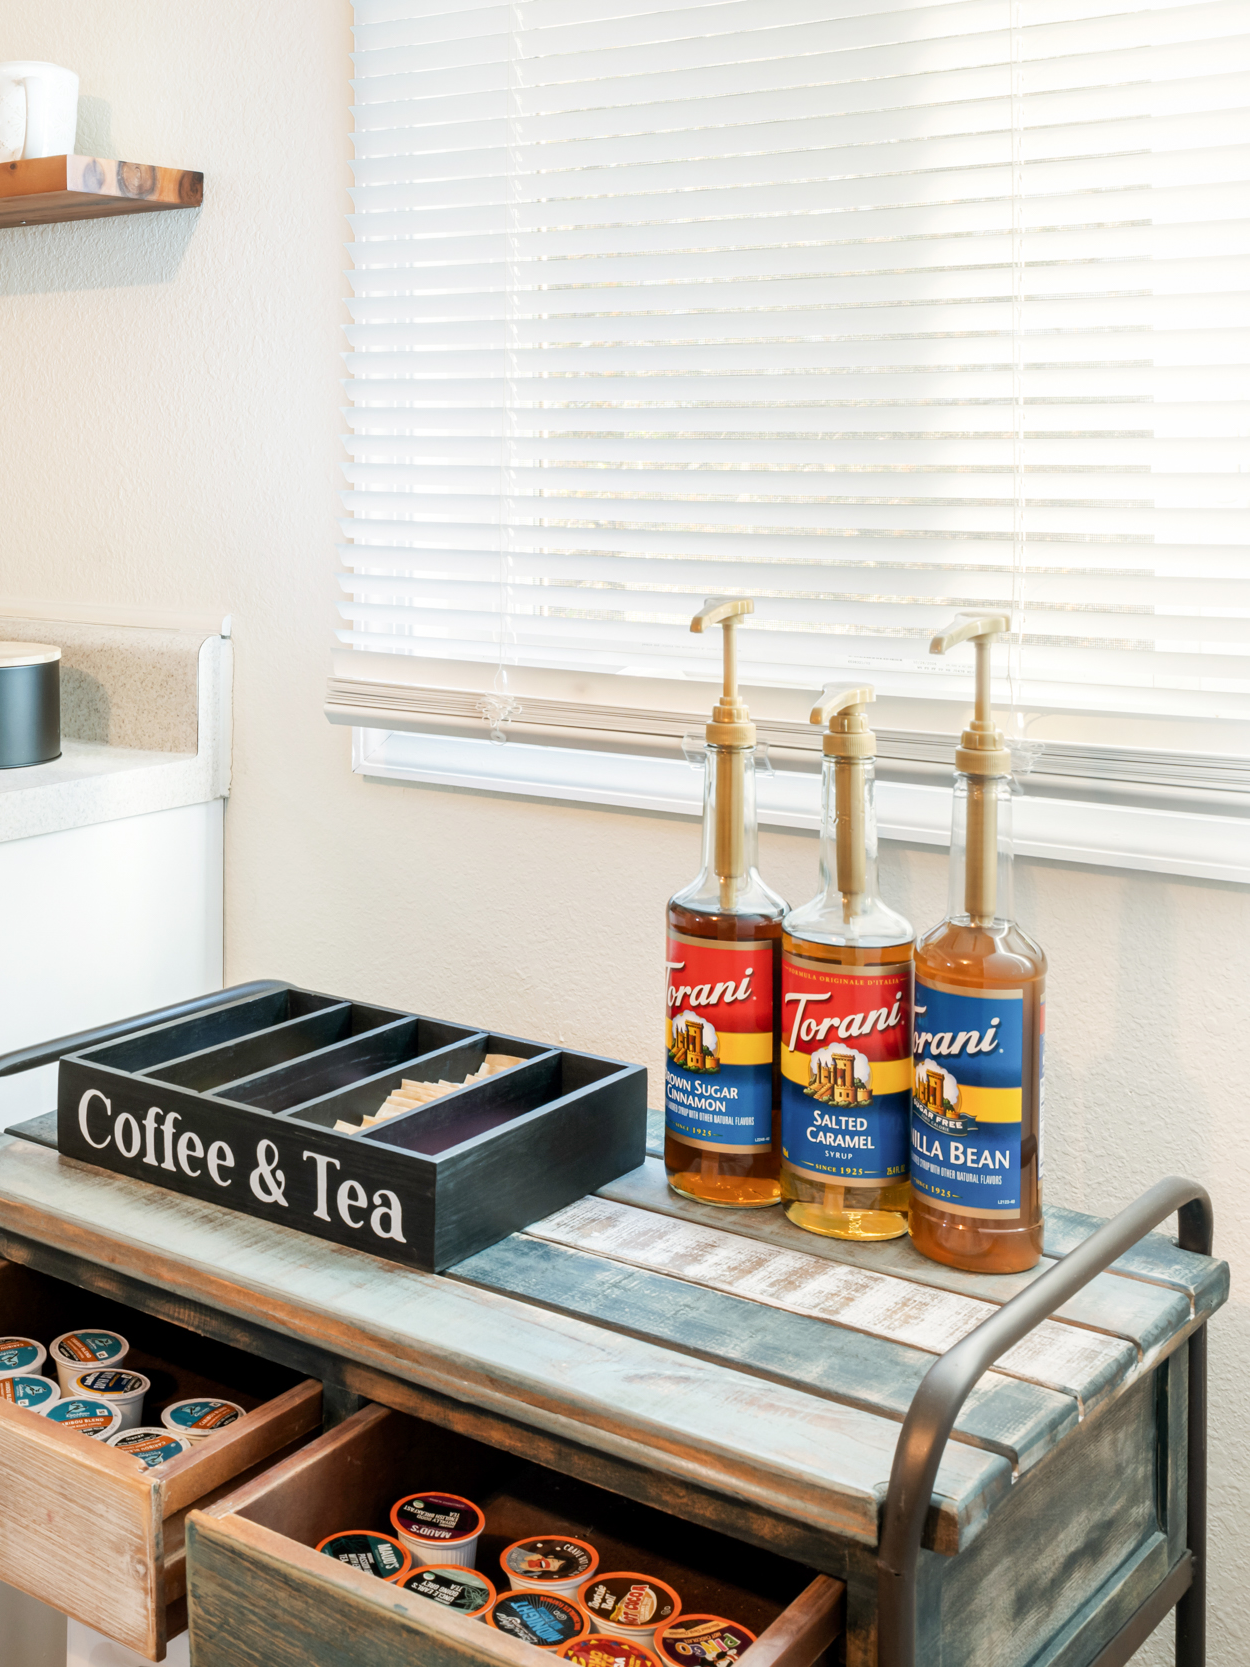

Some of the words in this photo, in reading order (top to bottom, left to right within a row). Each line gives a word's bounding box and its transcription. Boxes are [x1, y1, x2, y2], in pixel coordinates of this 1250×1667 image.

[819, 976, 864, 986] ORIGINALE
[868, 978, 900, 986] D'ITALIA
[785, 991, 902, 1052] Torani
[666, 1066, 691, 1092] ROWN
[694, 1080, 738, 1099] SUGAR
[667, 1084, 726, 1112] CINNAMON
[735, 1117, 754, 1126] FLAVORS
[813, 1110, 868, 1131] SALTED
[936, 1116, 963, 1129] FREE
[692, 1127, 712, 1137] 1925
[806, 1127, 875, 1149] CARAMEL
[825, 1150, 853, 1160] SYRUP
[950, 1141, 1010, 1169] BEAN
[78, 1088, 235, 1187] Coffee
[249, 1138, 289, 1208] &
[302, 1150, 406, 1244] Tea
[815, 1164, 836, 1173] SINCE
[840, 1167, 863, 1176] 1925
[981, 1175, 1002, 1185] FLAVORS
[931, 1186, 951, 1198] 1925
[141, 1441, 166, 1451] CARIBOU
[403, 1505, 435, 1518] BREAKFAST
[436, 1514, 459, 1522] ENGLISH
[410, 1525, 452, 1538] MAUD'S
[378, 1544, 400, 1569] MAUD'S
[563, 1544, 584, 1558] CRAVE
[339, 1554, 349, 1562] TEA
[411, 1582, 434, 1594] EARL'S
[422, 1580, 440, 1590] GREY
[450, 1584, 463, 1592] TEA
[432, 1590, 454, 1602] UNCLE
[439, 1587, 459, 1597] GOING
[588, 1584, 606, 1609] Tootsie
[624, 1585, 649, 1611] COCOA
[601, 1594, 616, 1610] Roll
[511, 1601, 564, 1642] MIDNIGHT
[675, 1633, 741, 1657] PINGO
[683, 1635, 711, 1644] CHOCOLATE
